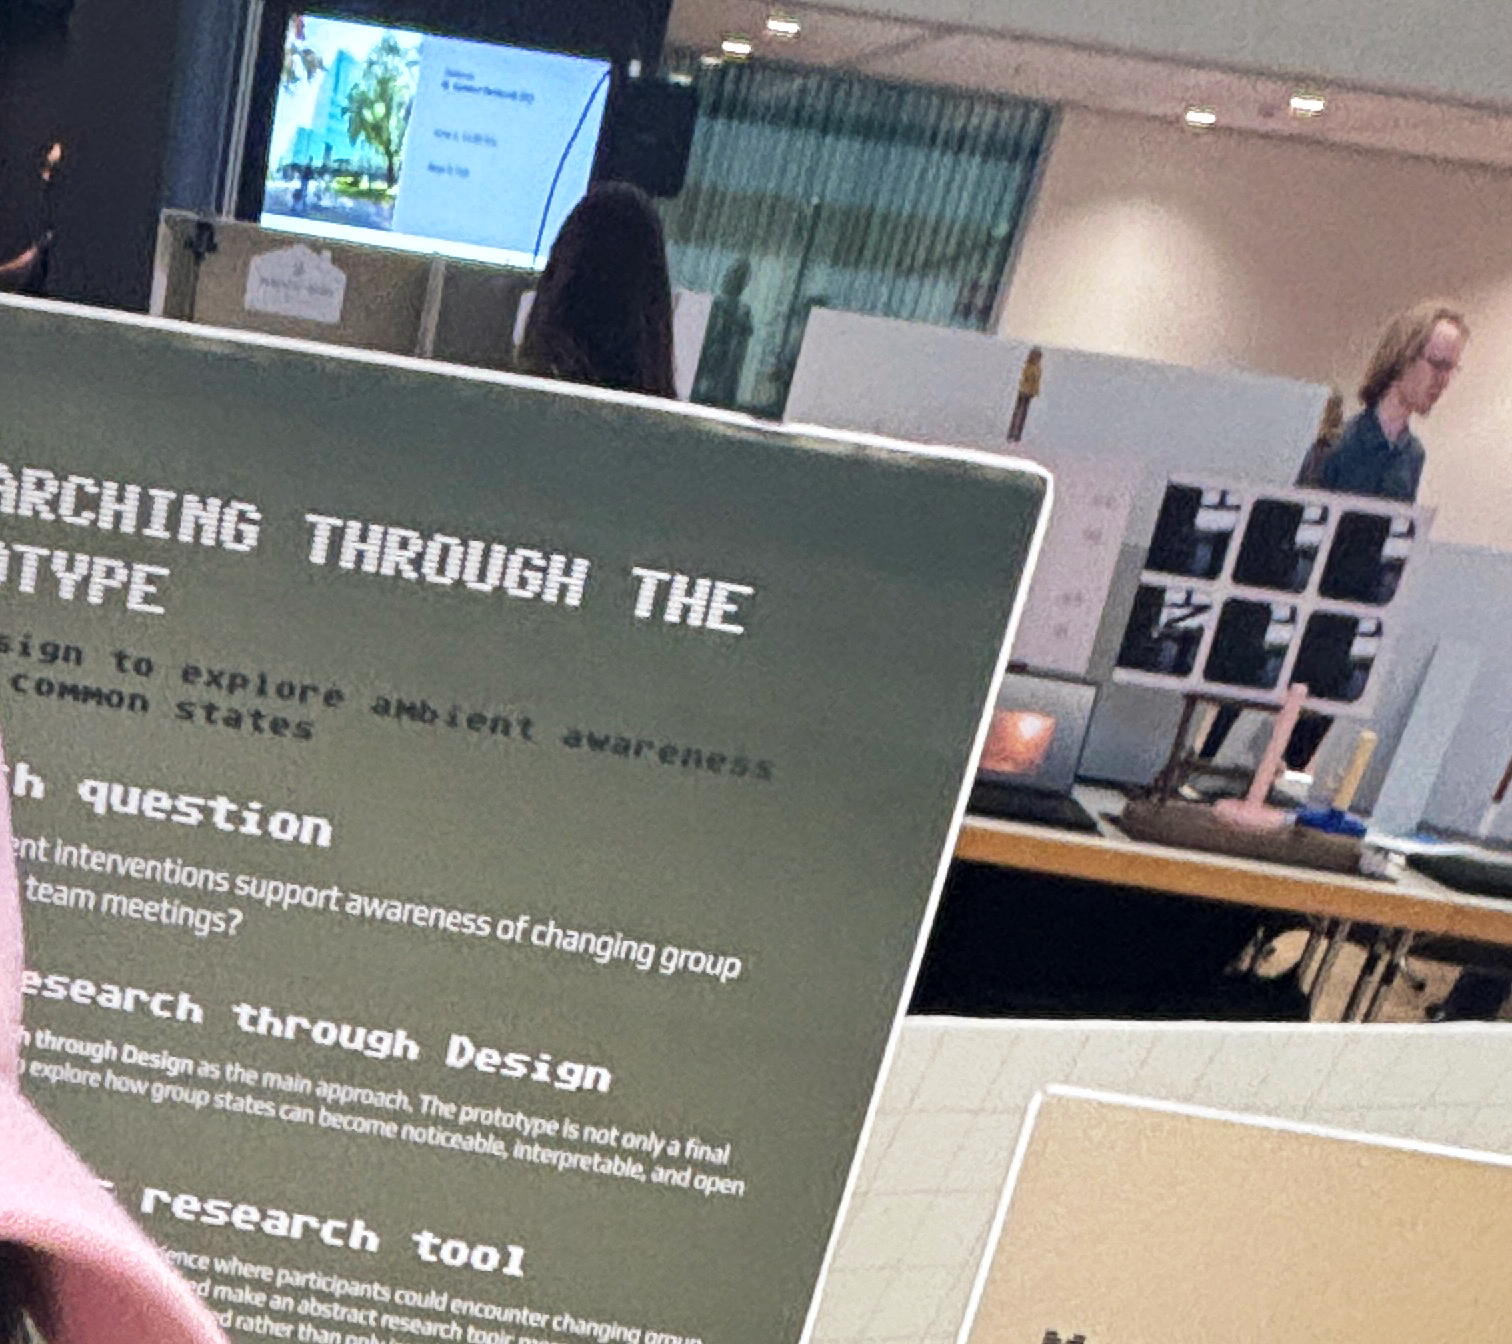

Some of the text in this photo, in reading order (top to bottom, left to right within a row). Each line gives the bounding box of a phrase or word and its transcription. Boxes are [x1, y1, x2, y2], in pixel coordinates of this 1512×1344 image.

[305, 513, 590, 606] THROUGH
[632, 567, 754, 634] THE
[10, 674, 313, 740] common states
[113, 651, 153, 677] to
[181, 665, 344, 707] explore
[371, 697, 533, 741] ambient
[563, 729, 774, 781] awareness
[78, 779, 332, 847] question
[26, 875, 243, 937] team meetings?
[55, 838, 741, 983] interventions support awareness of changing group
[232, 1003, 420, 1060] through
[445, 1034, 611, 1093] Design
[35, 1029, 731, 1164] through Design as the main approach. The prototype is not only a final
[140, 1187, 524, 1277] research tool
